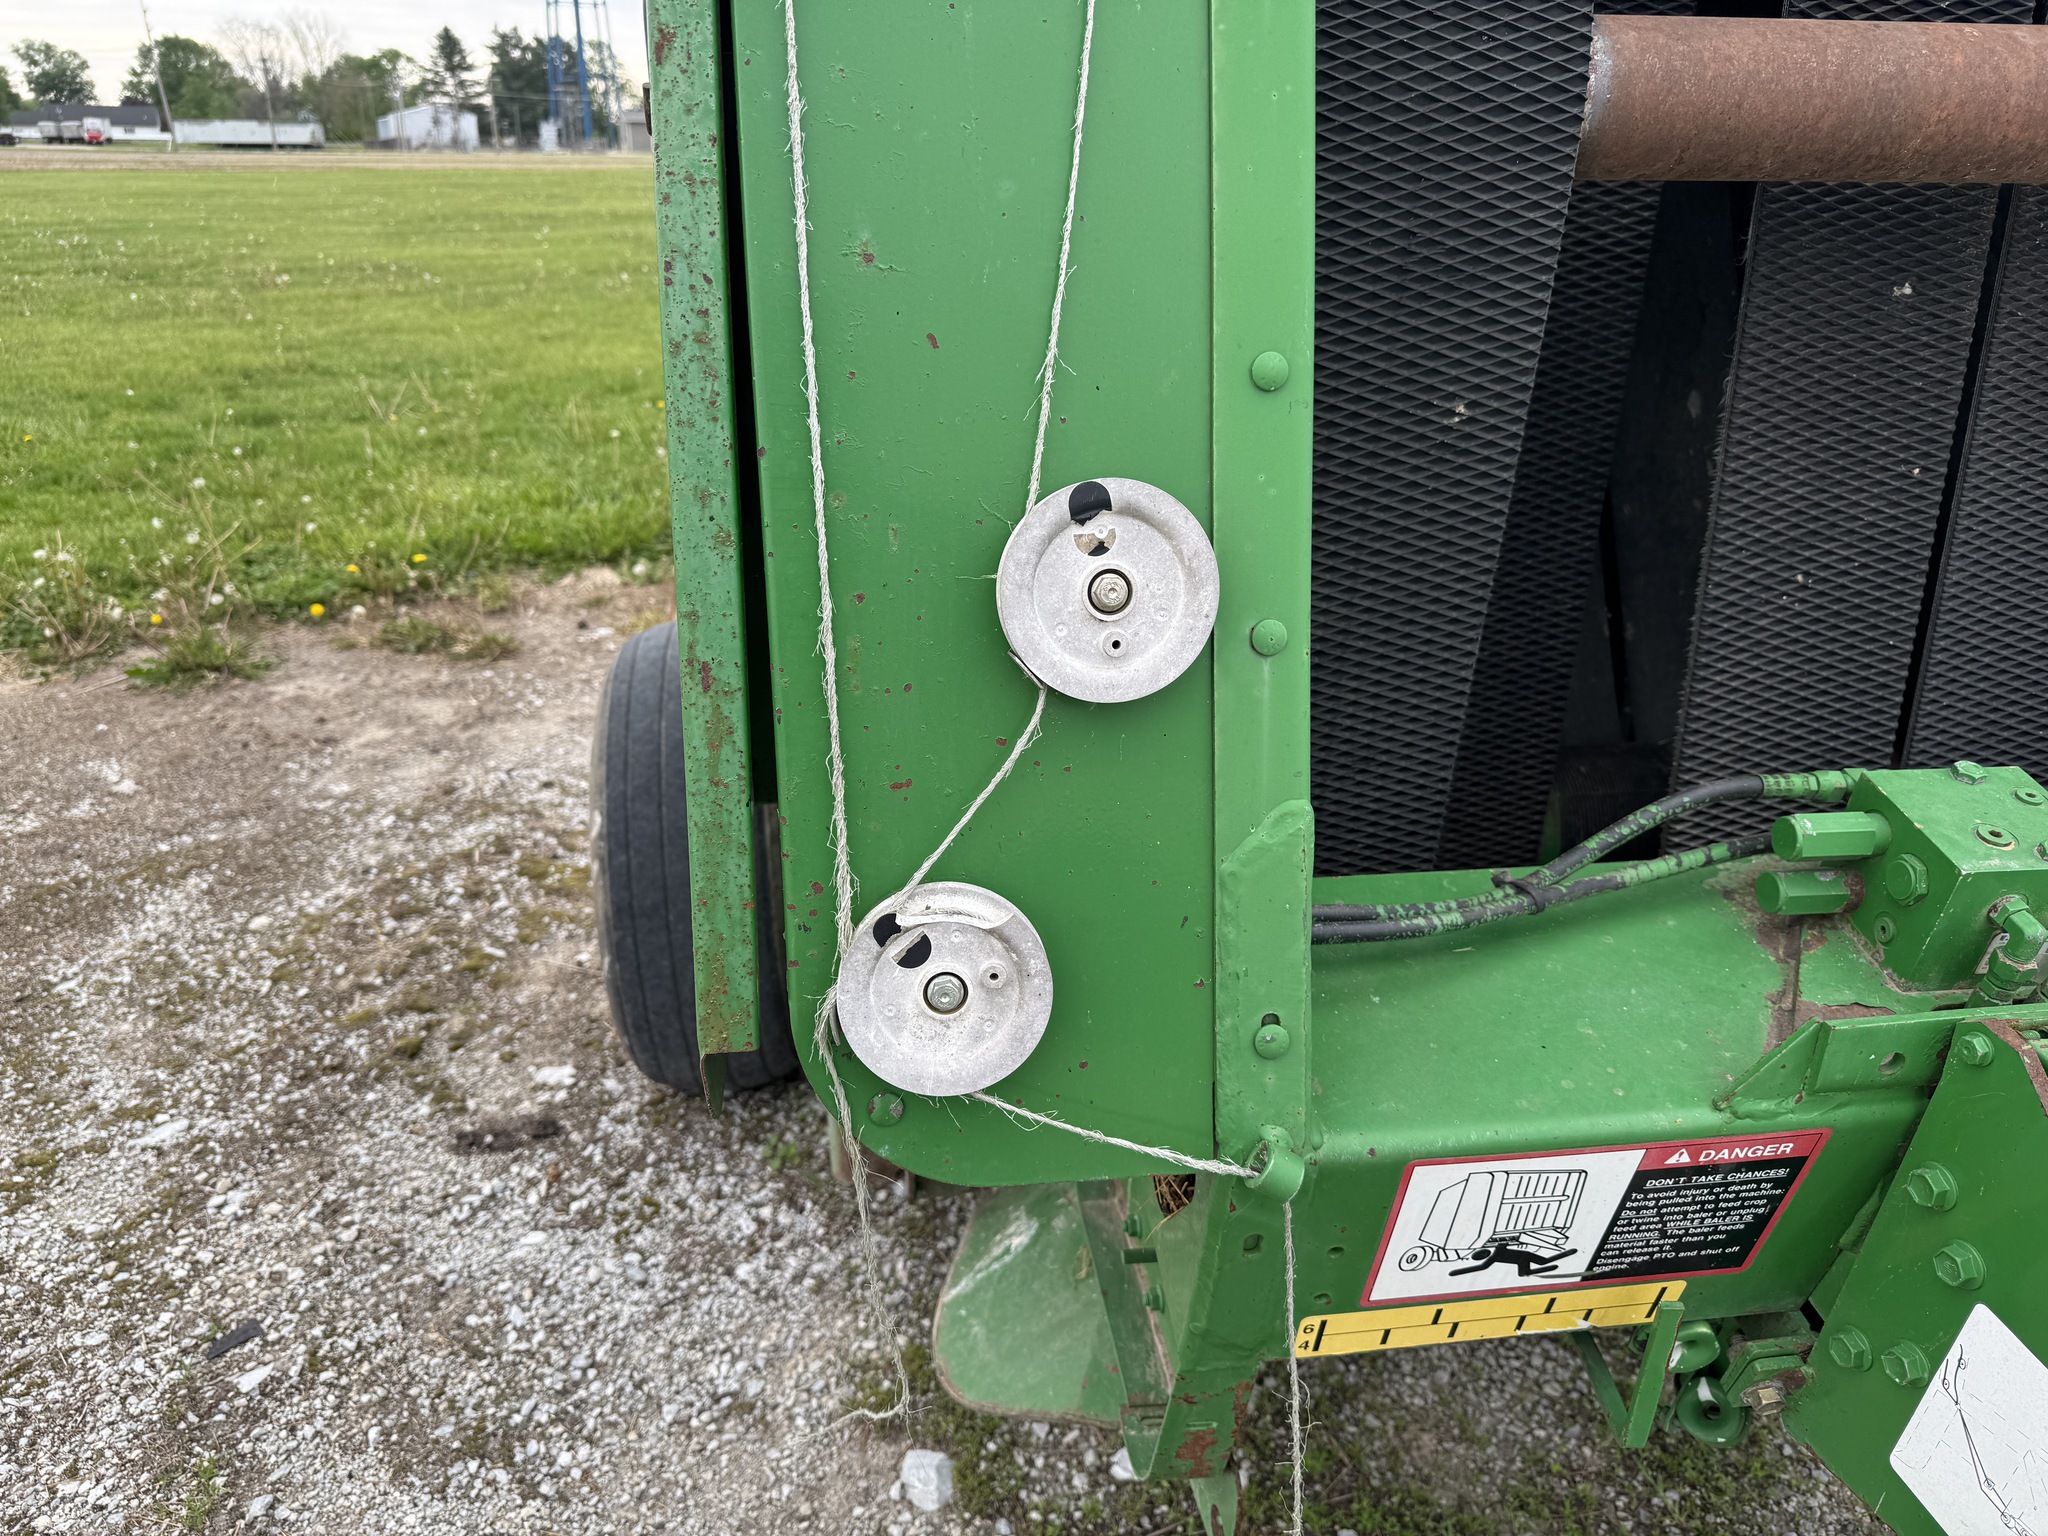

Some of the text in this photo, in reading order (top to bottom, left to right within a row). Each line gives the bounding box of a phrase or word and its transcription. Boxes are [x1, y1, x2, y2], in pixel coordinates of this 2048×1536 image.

[1698, 1143, 1794, 1162] DANGER
[1646, 1168, 1790, 1187] DON'T TAKE CHANCES!
[1631, 1192, 1644, 1200] To
[1647, 1190, 1677, 1199] avoid
[1680, 1188, 1710, 1196] injury
[1727, 1183, 1757, 1191] death
[1760, 1182, 1774, 1190] by
[1626, 1200, 1656, 1208] being
[1658, 1197, 1692, 1206] pulled
[1660, 1204, 1701, 1213] attempt
[1718, 1200, 1742, 1208] feed
[1744, 1198, 1767, 1206] crop
[1631, 1216, 1660, 1224] twine
[1686, 1211, 1714, 1219] baler
[1666, 1219, 1701, 1227] WHILE
[1704, 1215, 1740, 1224] BALER
[1608, 1231, 1661, 1240] RUNNING.
[1688, 1226, 1715, 1234] baler
[1717, 1223, 1746, 1231] feeds
[1604, 1240, 1646, 1249] material
[1649, 1237, 1679, 1245] faster
[1706, 1233, 1727, 1241] you
[1622, 1246, 1660, 1254] release
[1596, 1255, 1650, 1265] Disengage
[1653, 1252, 1676, 1260] PTO
[1593, 1264, 1629, 1273] engine.
[1303, 1323, 1315, 1334] 6
[1298, 1340, 1310, 1351] 4
